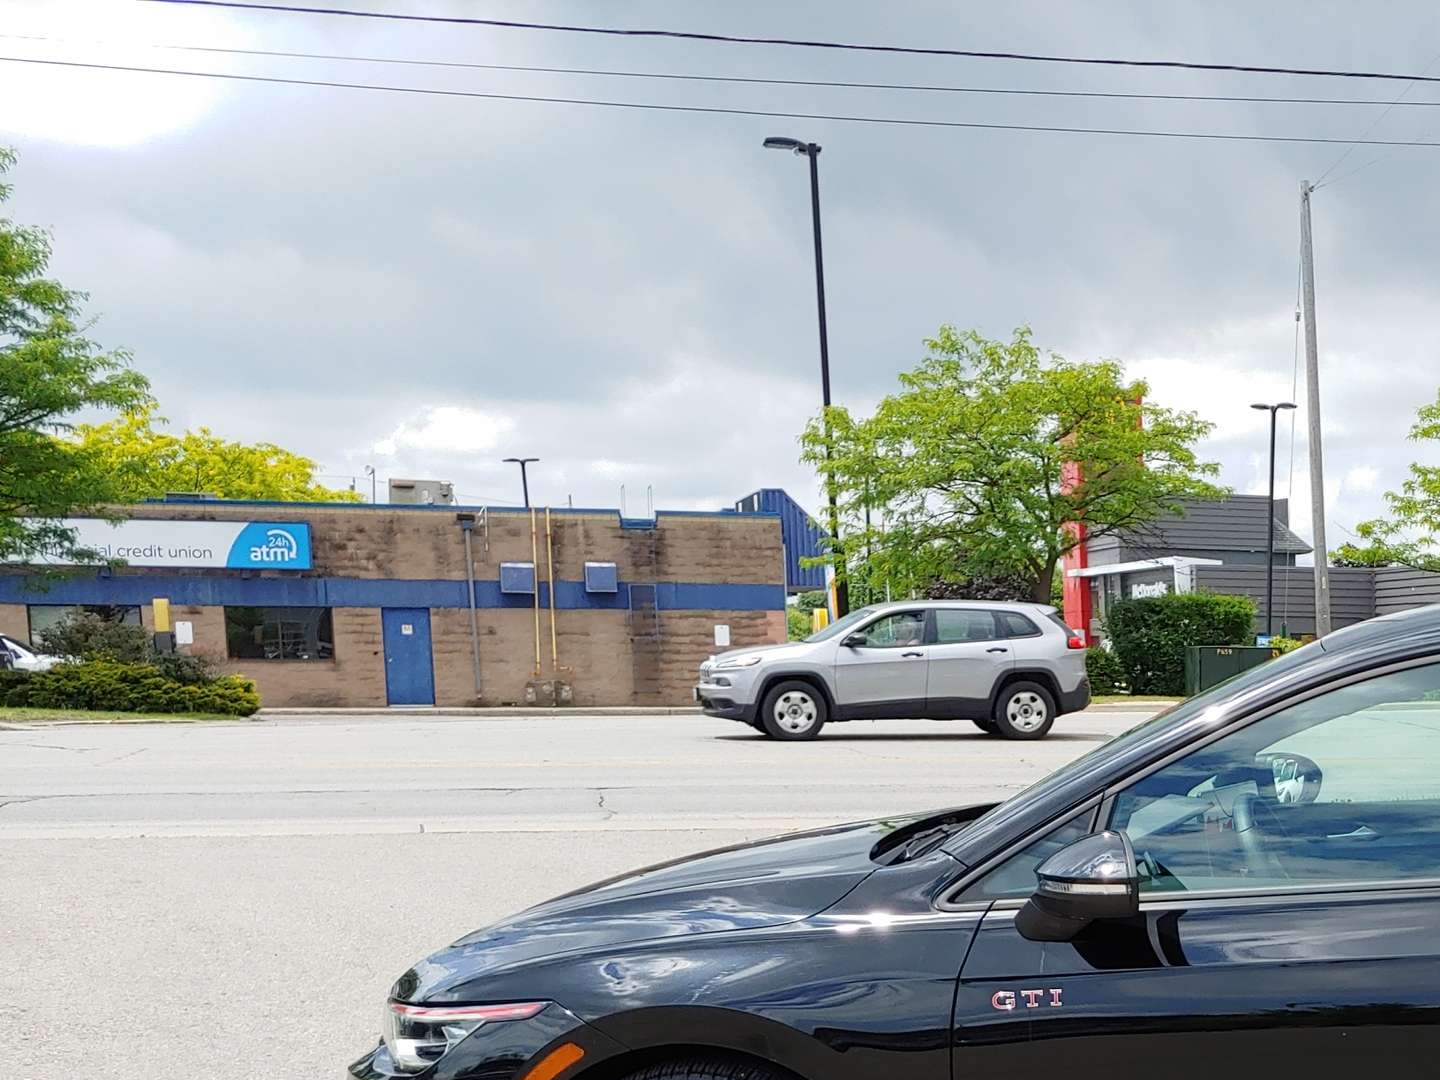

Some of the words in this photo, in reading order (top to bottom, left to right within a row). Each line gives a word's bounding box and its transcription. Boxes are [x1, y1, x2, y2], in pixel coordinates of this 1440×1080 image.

[268, 536, 289, 548] 24h
[117, 543, 163, 559] credit
[168, 545, 213, 560] union
[250, 545, 289, 562] atm
[991, 988, 1063, 1010] GTI
